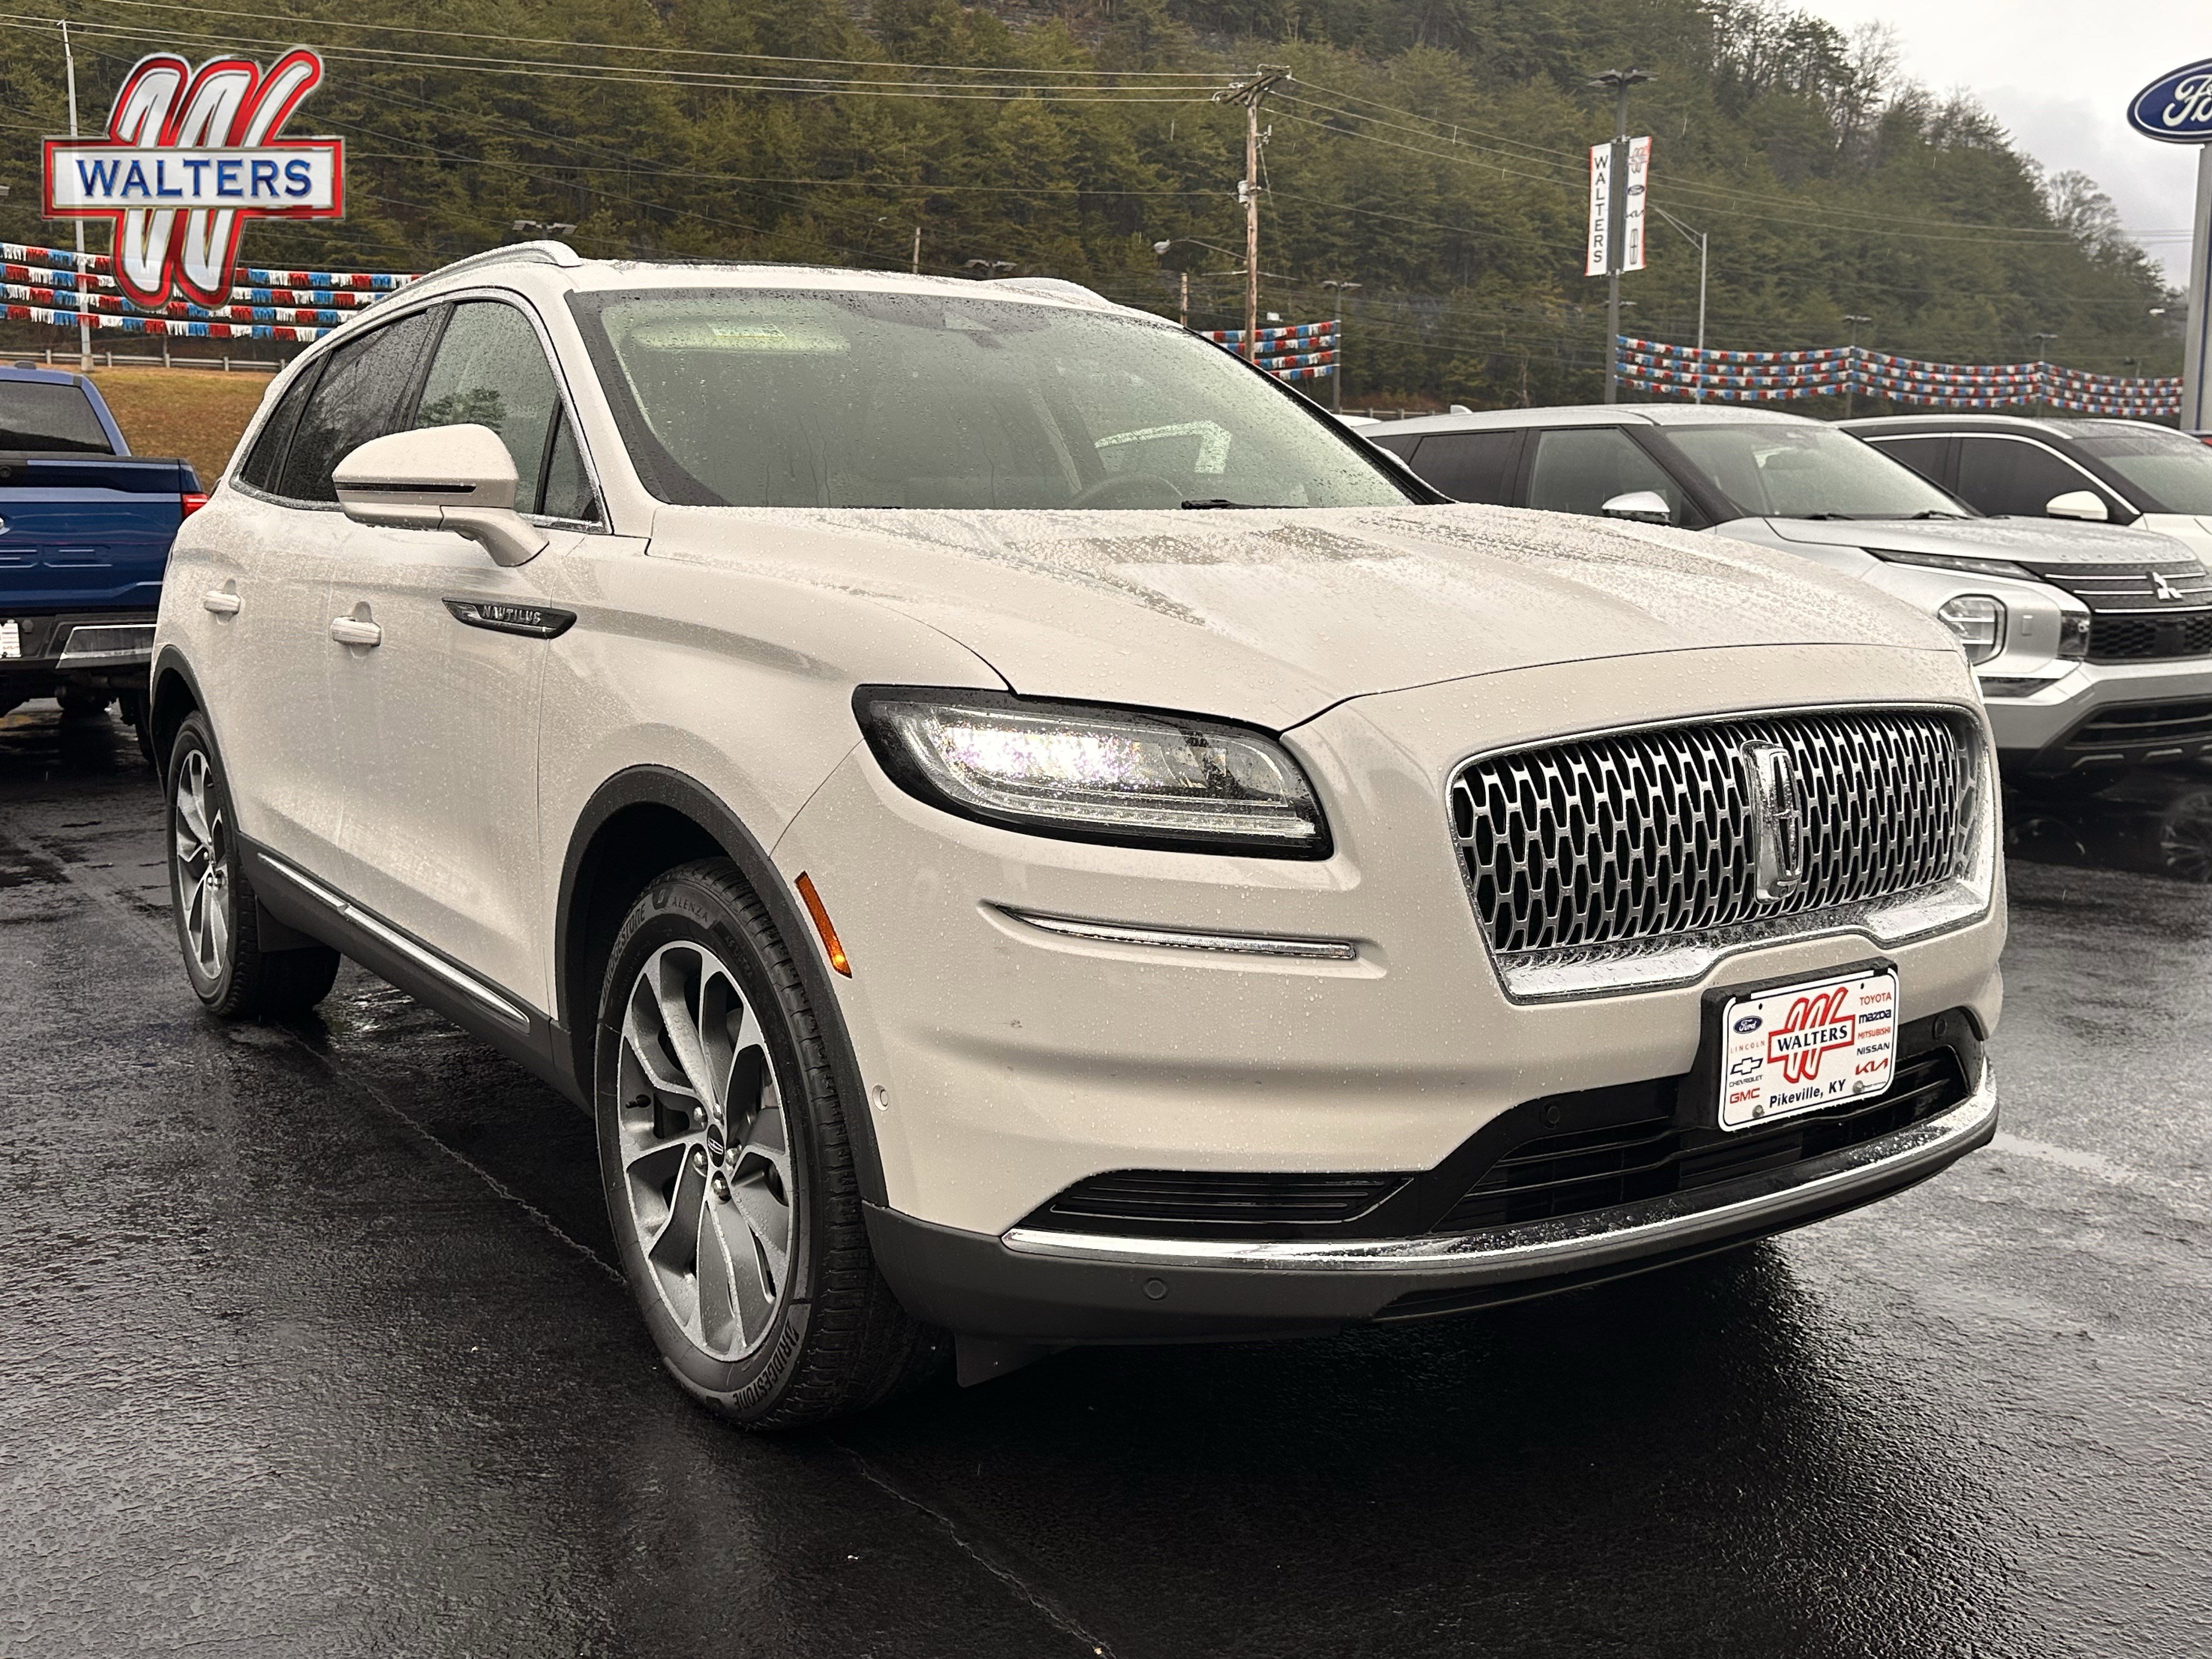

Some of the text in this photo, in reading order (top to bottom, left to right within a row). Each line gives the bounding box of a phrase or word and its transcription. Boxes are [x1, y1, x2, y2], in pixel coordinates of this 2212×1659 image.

[2163, 74, 2212, 127] Fo
[1593, 155, 1608, 263] WALTERS
[482, 605, 541, 625] NAUTILUS
[672, 896, 708, 922] ALENZA
[1860, 992, 1892, 1005] TOYOTA
[1739, 1019, 1757, 1031] Ford
[1858, 1026, 1891, 1040] MITSUBISHI
[1730, 1040, 1765, 1054] LINCOLN
[1778, 1025, 1848, 1052] WALTERS
[1857, 1042, 1890, 1056] NISSAN
[1729, 1075, 1763, 1087] CHEVROLET
[1730, 1087, 1760, 1104] GMC
[1769, 1086, 1824, 1108] Pikeville,
[1829, 1079, 1847, 1094] KY
[732, 1318, 799, 1410] BRIDGESTONE
